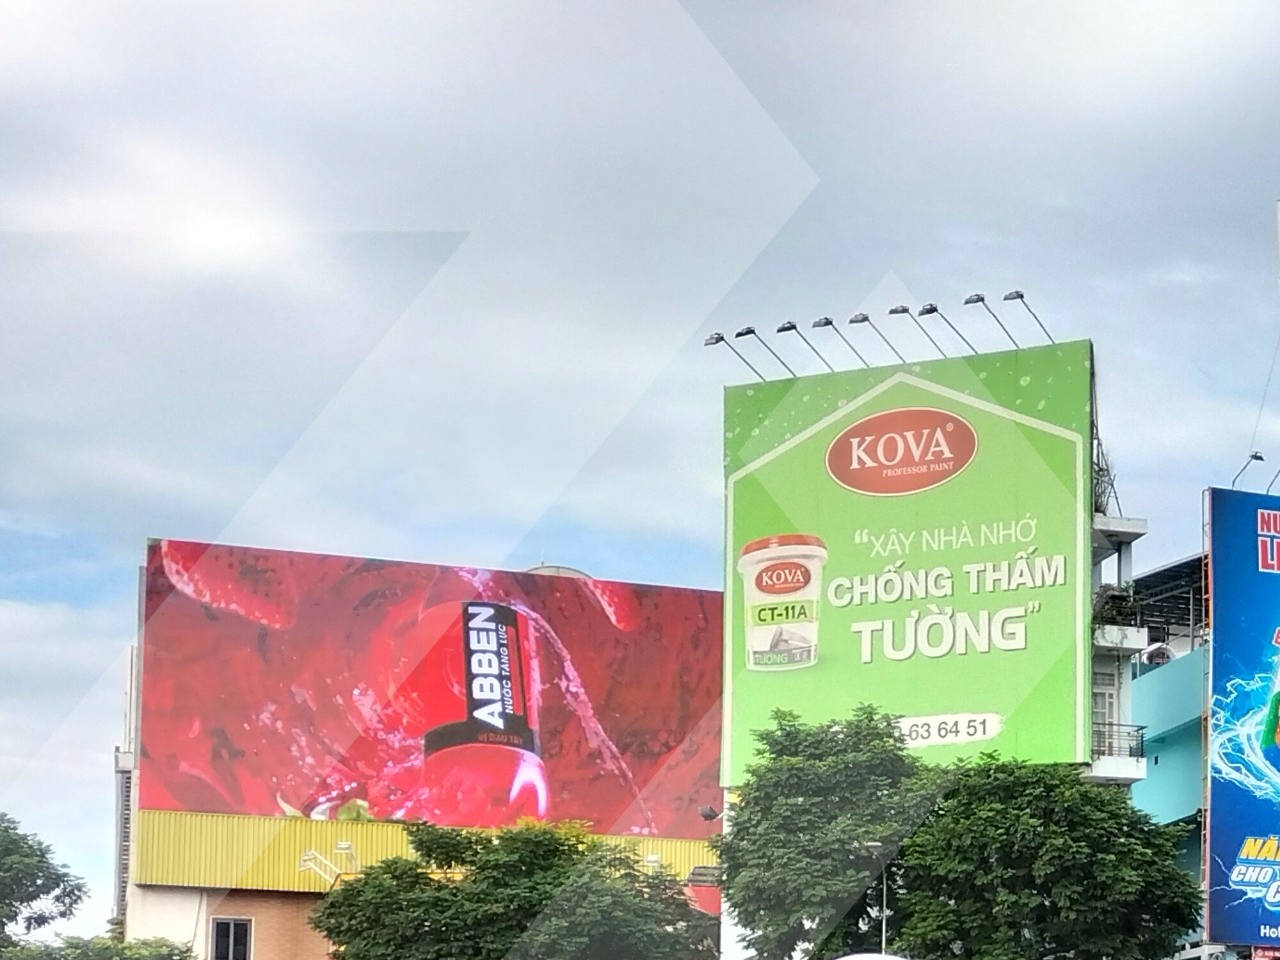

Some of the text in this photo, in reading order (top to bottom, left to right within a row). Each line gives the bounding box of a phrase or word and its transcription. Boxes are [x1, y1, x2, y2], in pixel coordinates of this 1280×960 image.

[882, 461, 955, 478] PROFESSOR PAINT
[922, 520, 974, 552] NHÀ
[827, 546, 1067, 607] CHỐNG THẤM
[758, 604, 808, 622] CT-11A
[468, 606, 505, 730] ABBEN
[938, 720, 960, 739] 64
[966, 719, 987, 737] 51
[1230, 865, 1274, 884] CHO
